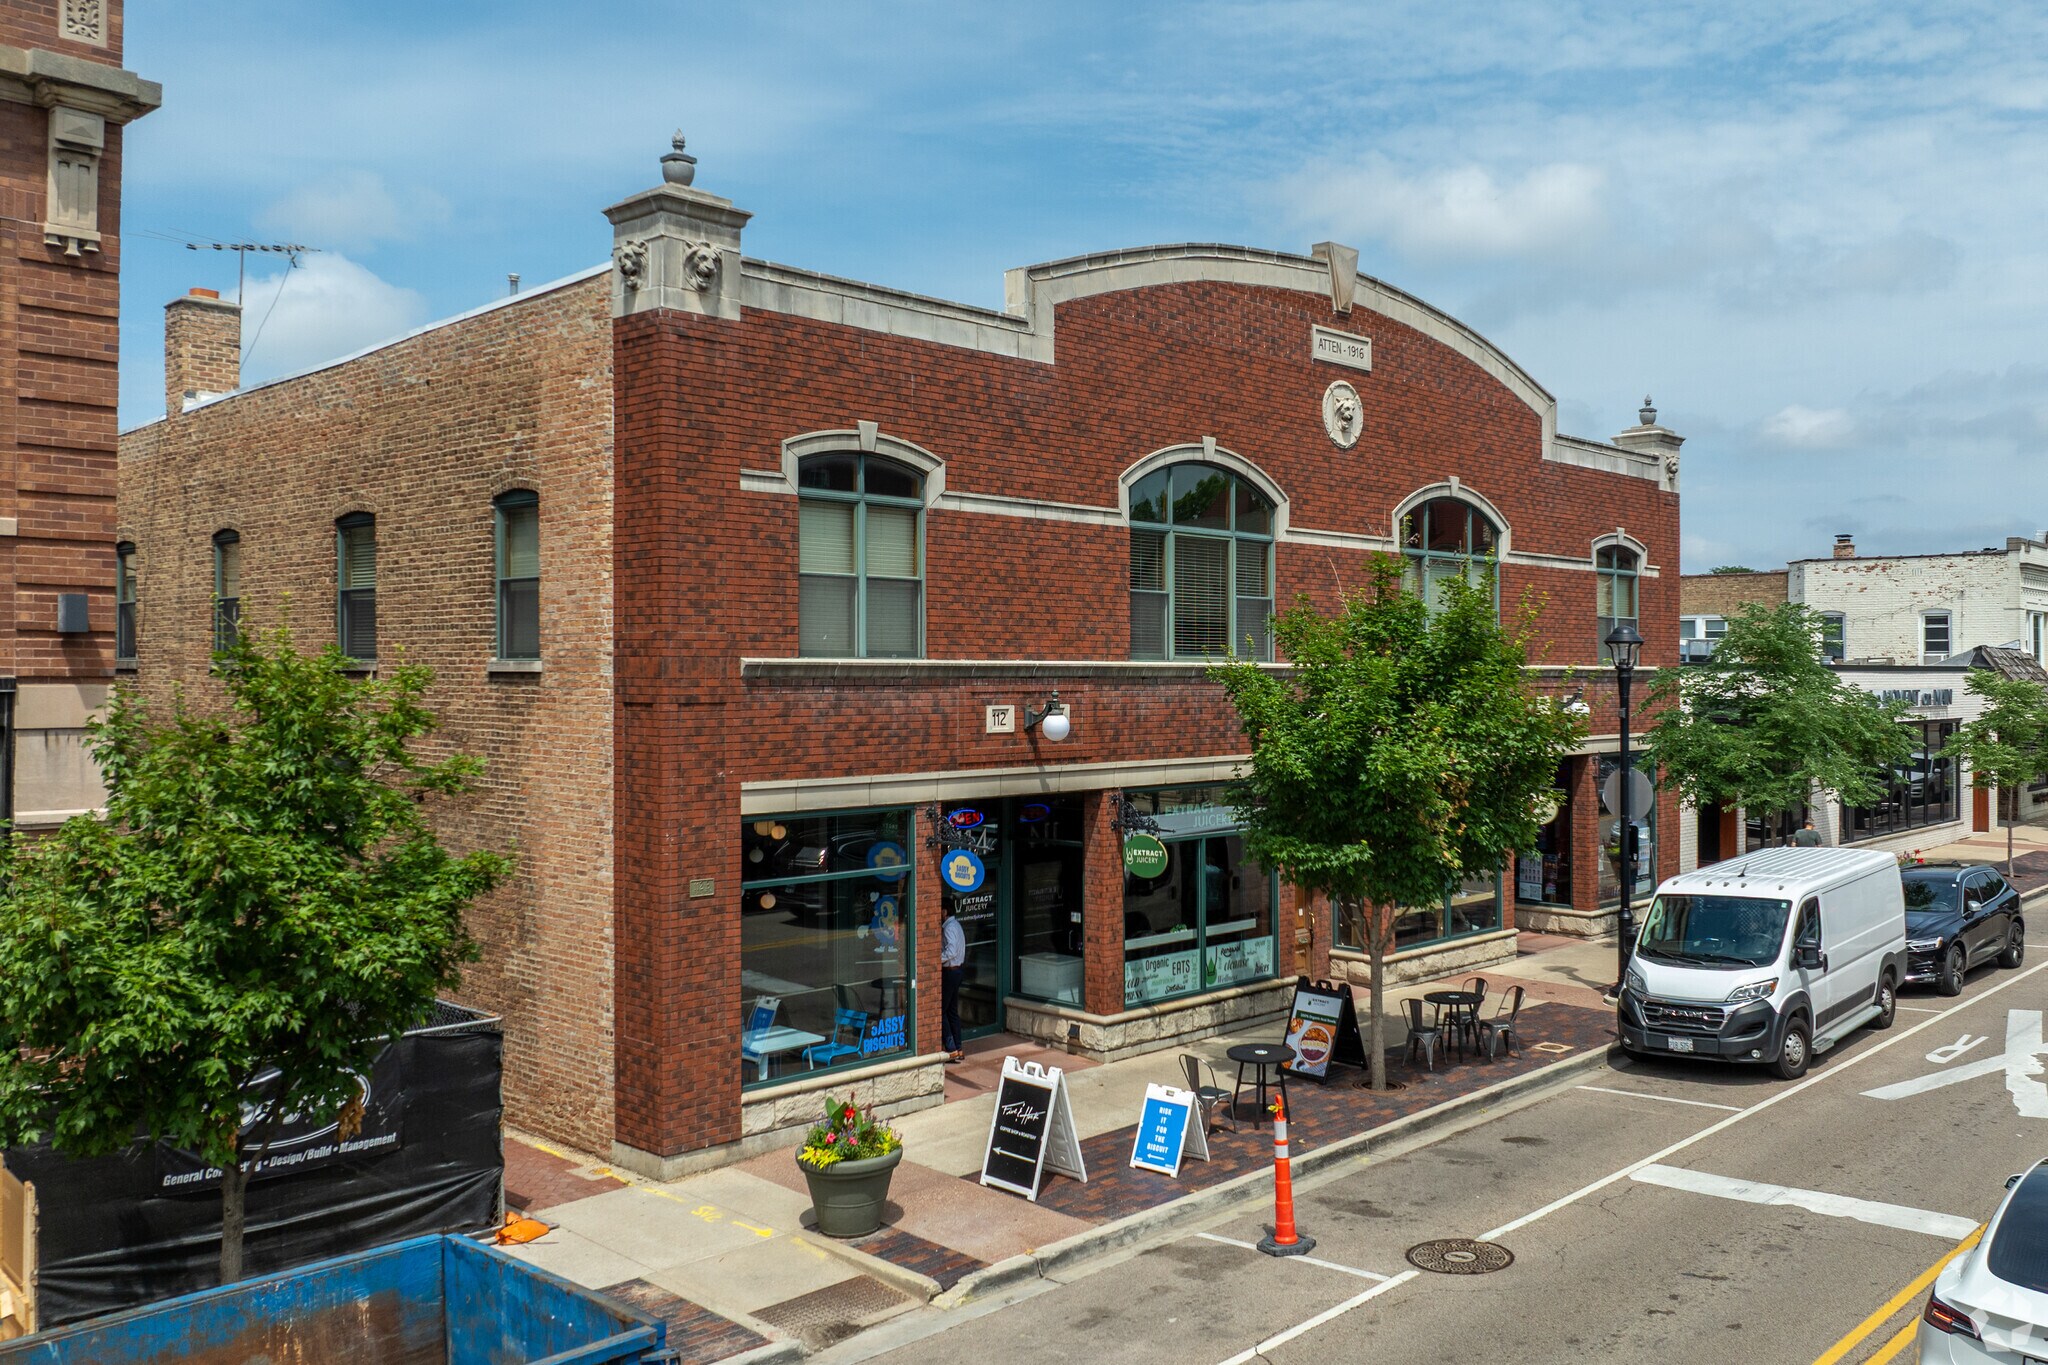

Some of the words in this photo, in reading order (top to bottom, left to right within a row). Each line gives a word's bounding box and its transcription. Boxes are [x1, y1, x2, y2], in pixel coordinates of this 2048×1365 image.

[1318, 338, 1342, 354] ATTEN
[1347, 345, 1365, 359] 1916
[992, 711, 1007, 726] 112
[1164, 801, 1215, 816] EXTRACT
[1133, 849, 1163, 857] EXTRACT
[1136, 856, 1158, 864] JUICERY
[962, 894, 993, 905] EXTRACT
[965, 902, 988, 912] JUICERY
[1145, 957, 1170, 973] Organic
[1172, 959, 1191, 976] EATS
[864, 1032, 905, 1053] BISCUITS
[1158, 1106, 1172, 1116] RISK
[1160, 1116, 1167, 1124] IT
[1156, 1125, 1168, 1134] FOR
[1154, 1134, 1165, 1144] THE
[1146, 1142, 1169, 1154] BISCUIT
[163, 1169, 204, 1187] General
[269, 1145, 332, 1168] Design/Build
[338, 1131, 397, 1154] Management
